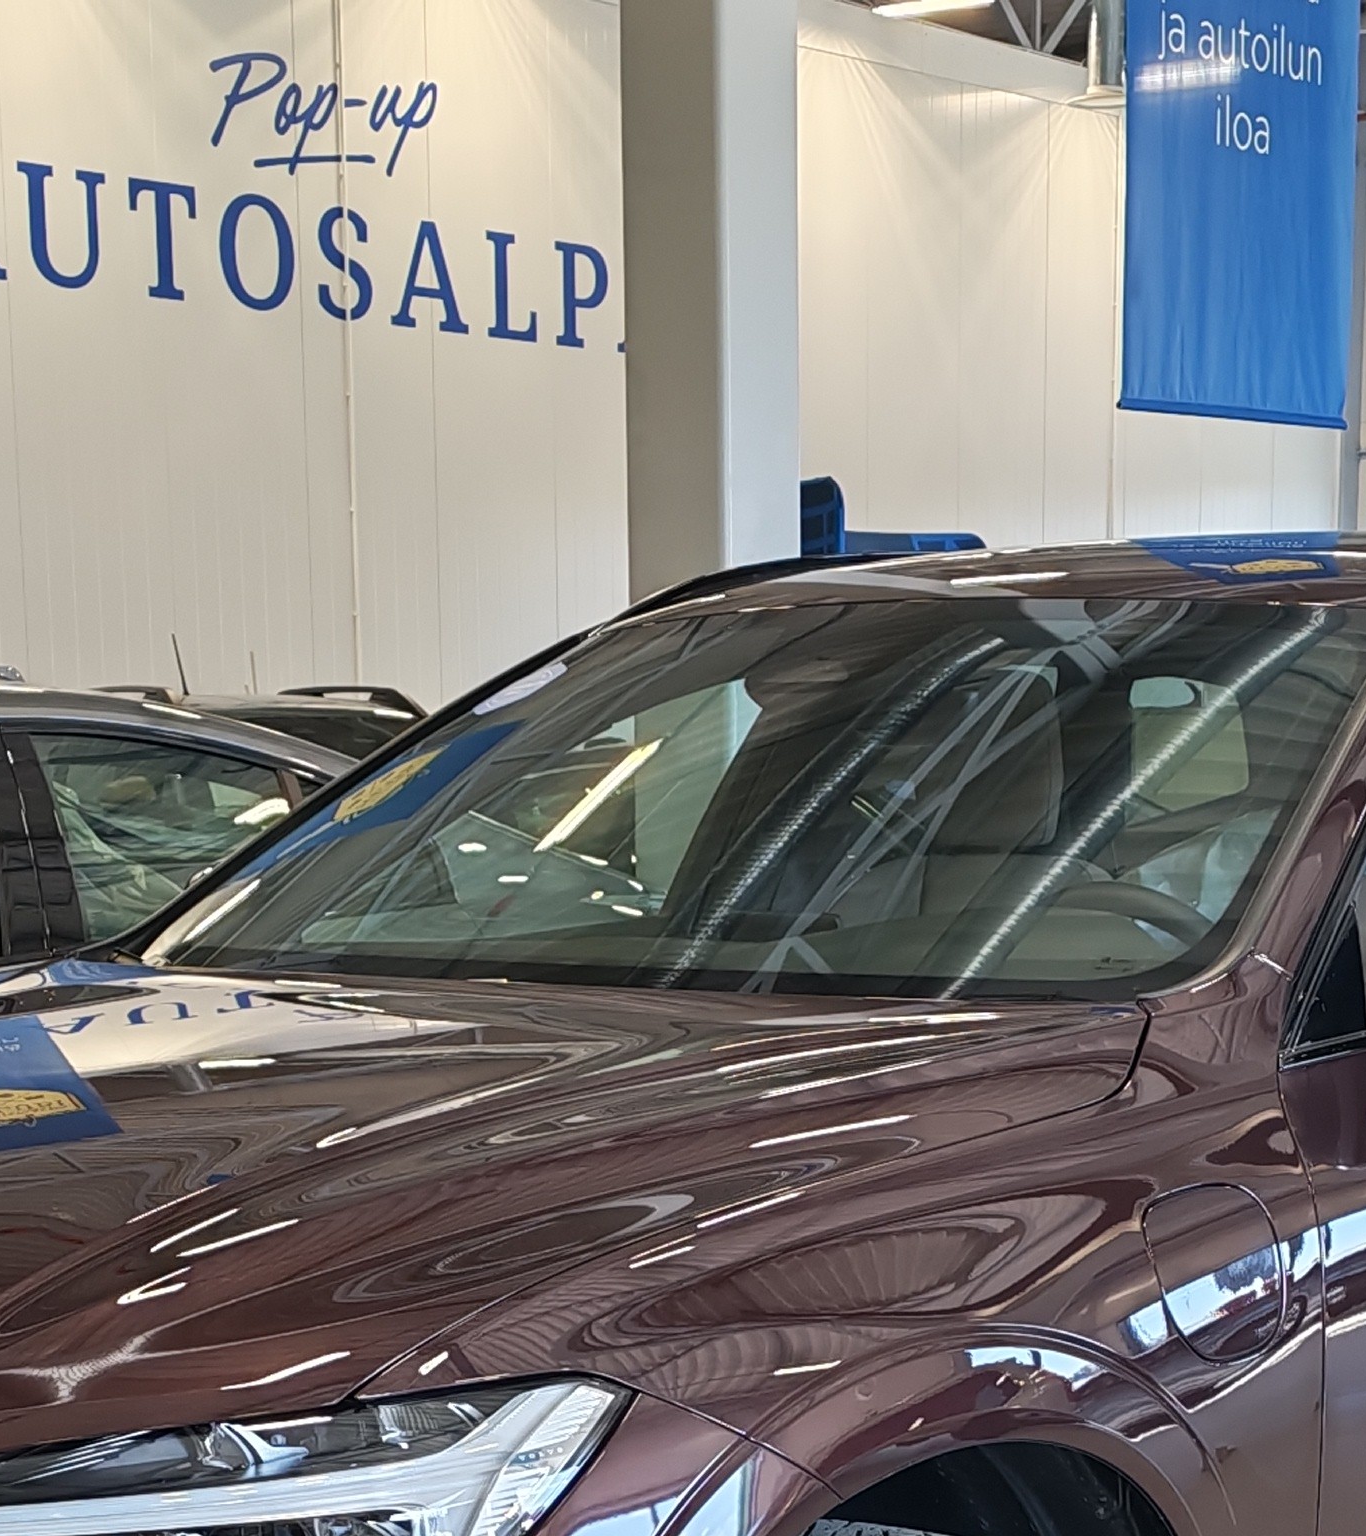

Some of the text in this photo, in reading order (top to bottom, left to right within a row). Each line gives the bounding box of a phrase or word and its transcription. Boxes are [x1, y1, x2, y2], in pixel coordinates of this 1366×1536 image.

[1158, 0, 1323, 86] ja autoilun
[209, 52, 438, 176] Pop-up
[1215, 94, 1271, 155] iloa
[518, 1446, 564, 1462] VOLVO
